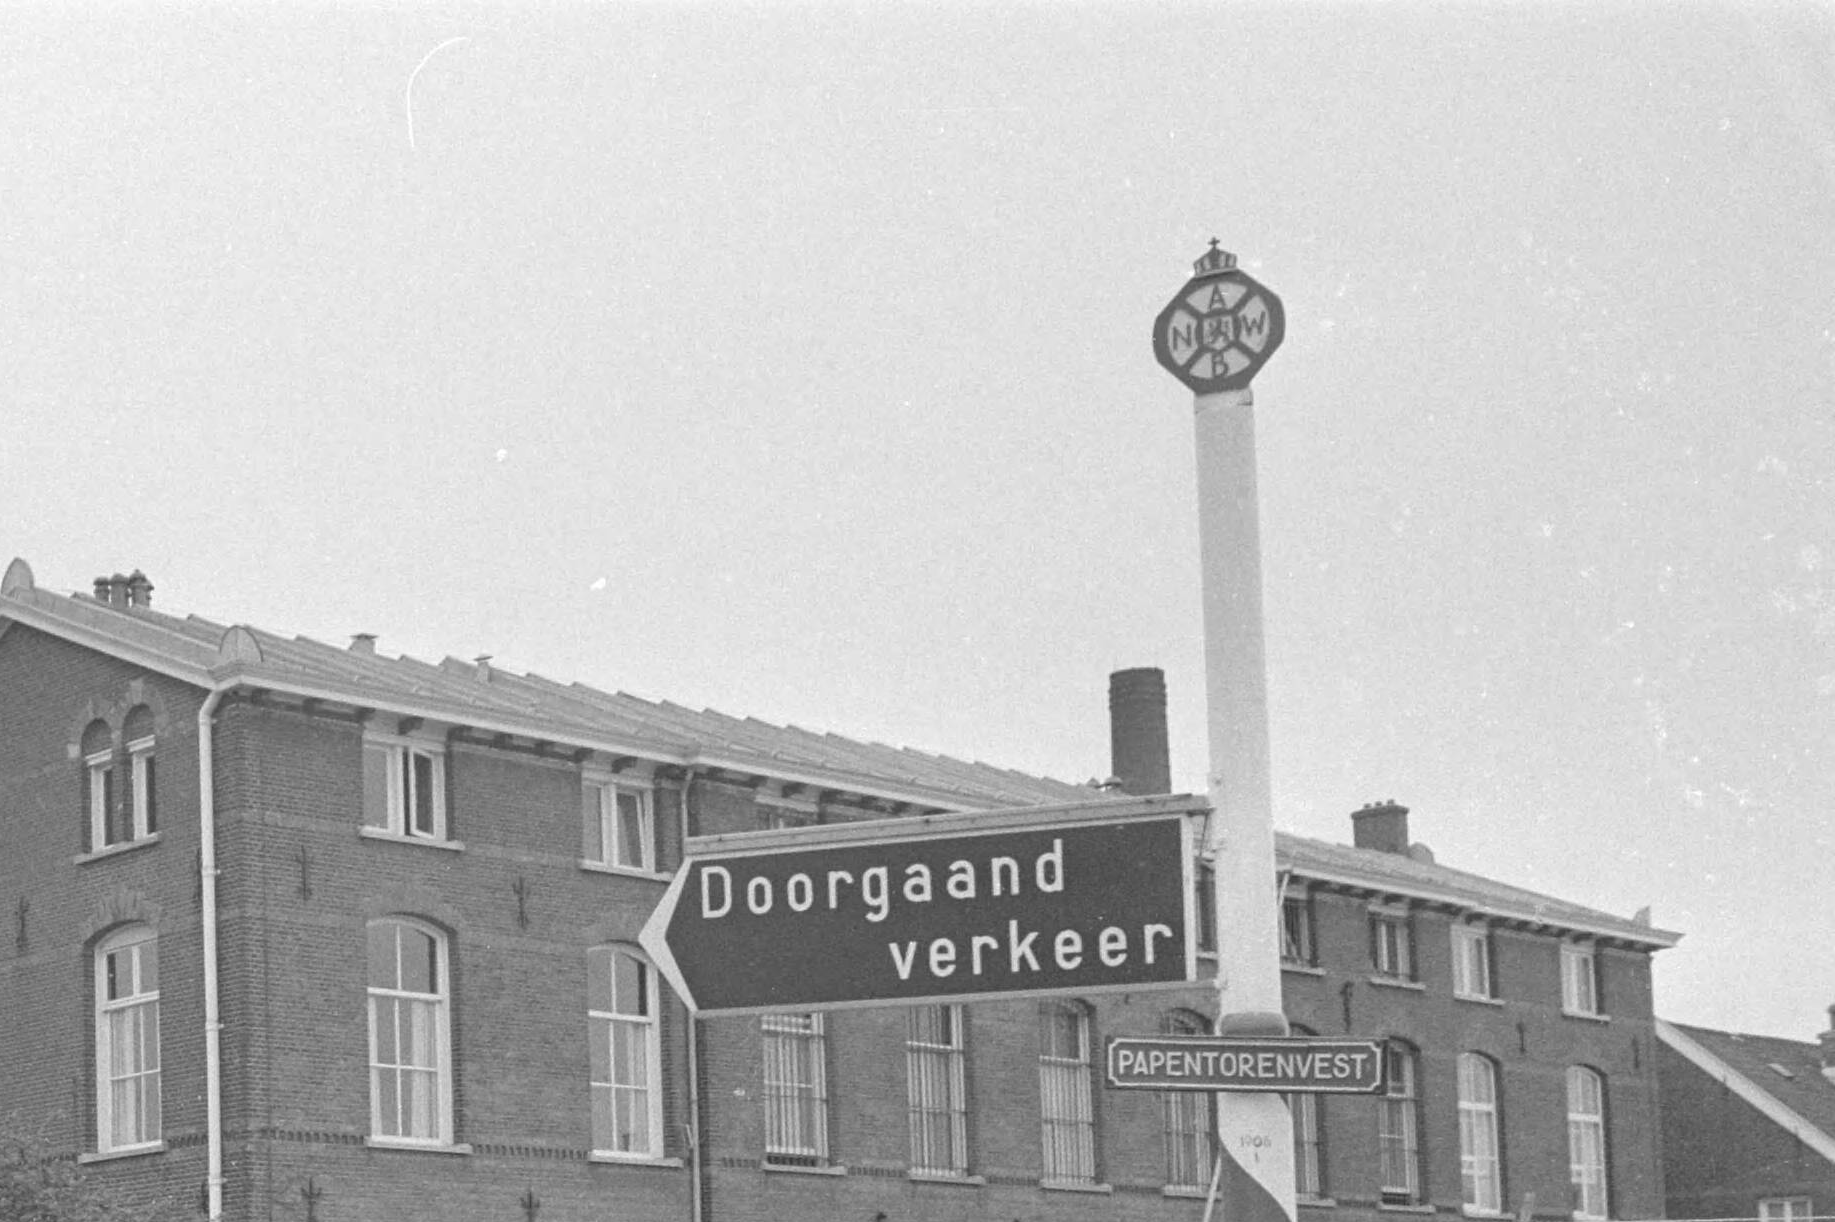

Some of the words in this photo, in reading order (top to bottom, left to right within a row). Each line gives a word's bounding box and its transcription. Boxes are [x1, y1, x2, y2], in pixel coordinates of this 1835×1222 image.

[701, 839, 1065, 923] Doorgaand
[888, 919, 1174, 981] verkeer
[1118, 1051, 1368, 1080] PAPENTORENVEST
